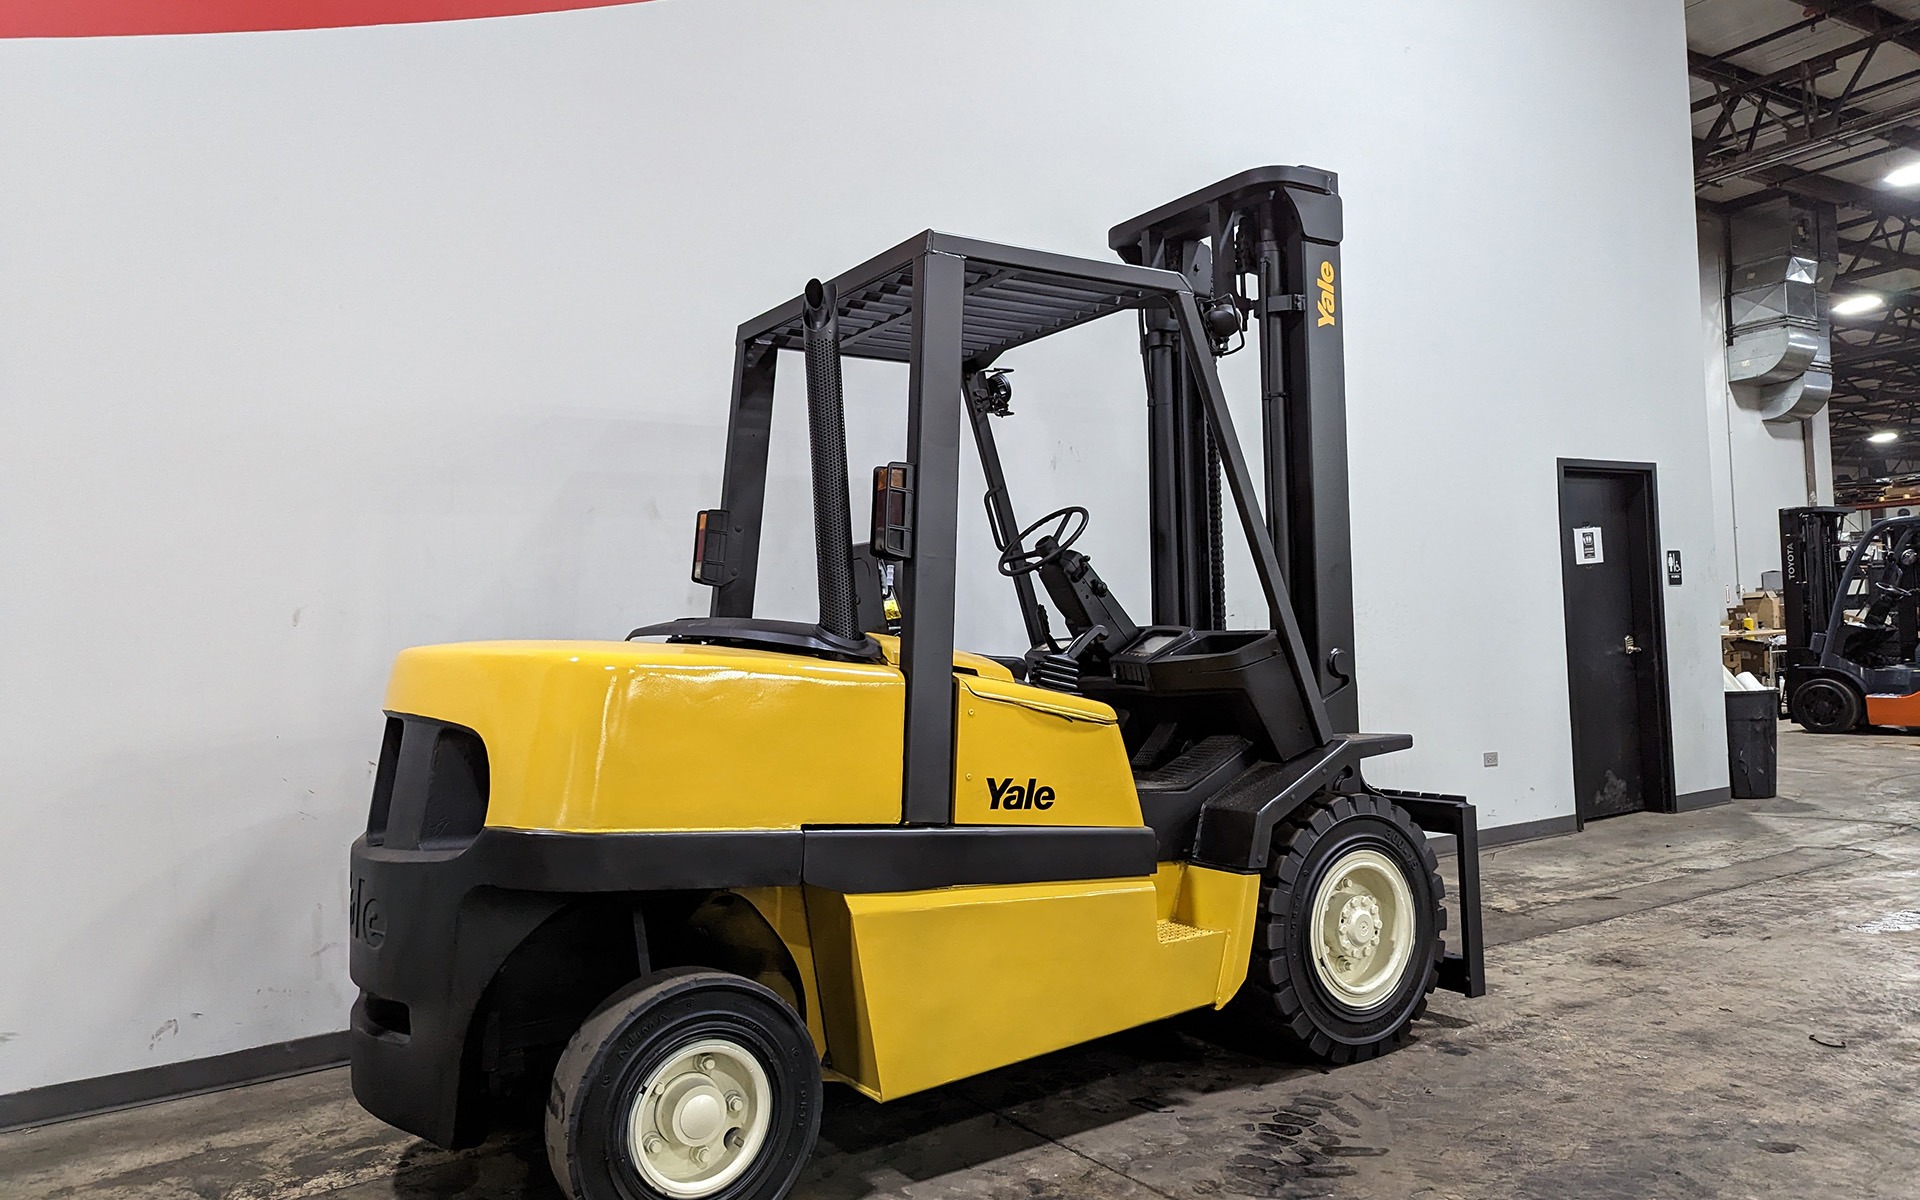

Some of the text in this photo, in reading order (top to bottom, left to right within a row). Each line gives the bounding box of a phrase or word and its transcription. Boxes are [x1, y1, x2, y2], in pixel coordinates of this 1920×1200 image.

[1316, 260, 1335, 328] Yale
[1786, 542, 1795, 580] TOYOTA
[985, 777, 1056, 810] Yale
